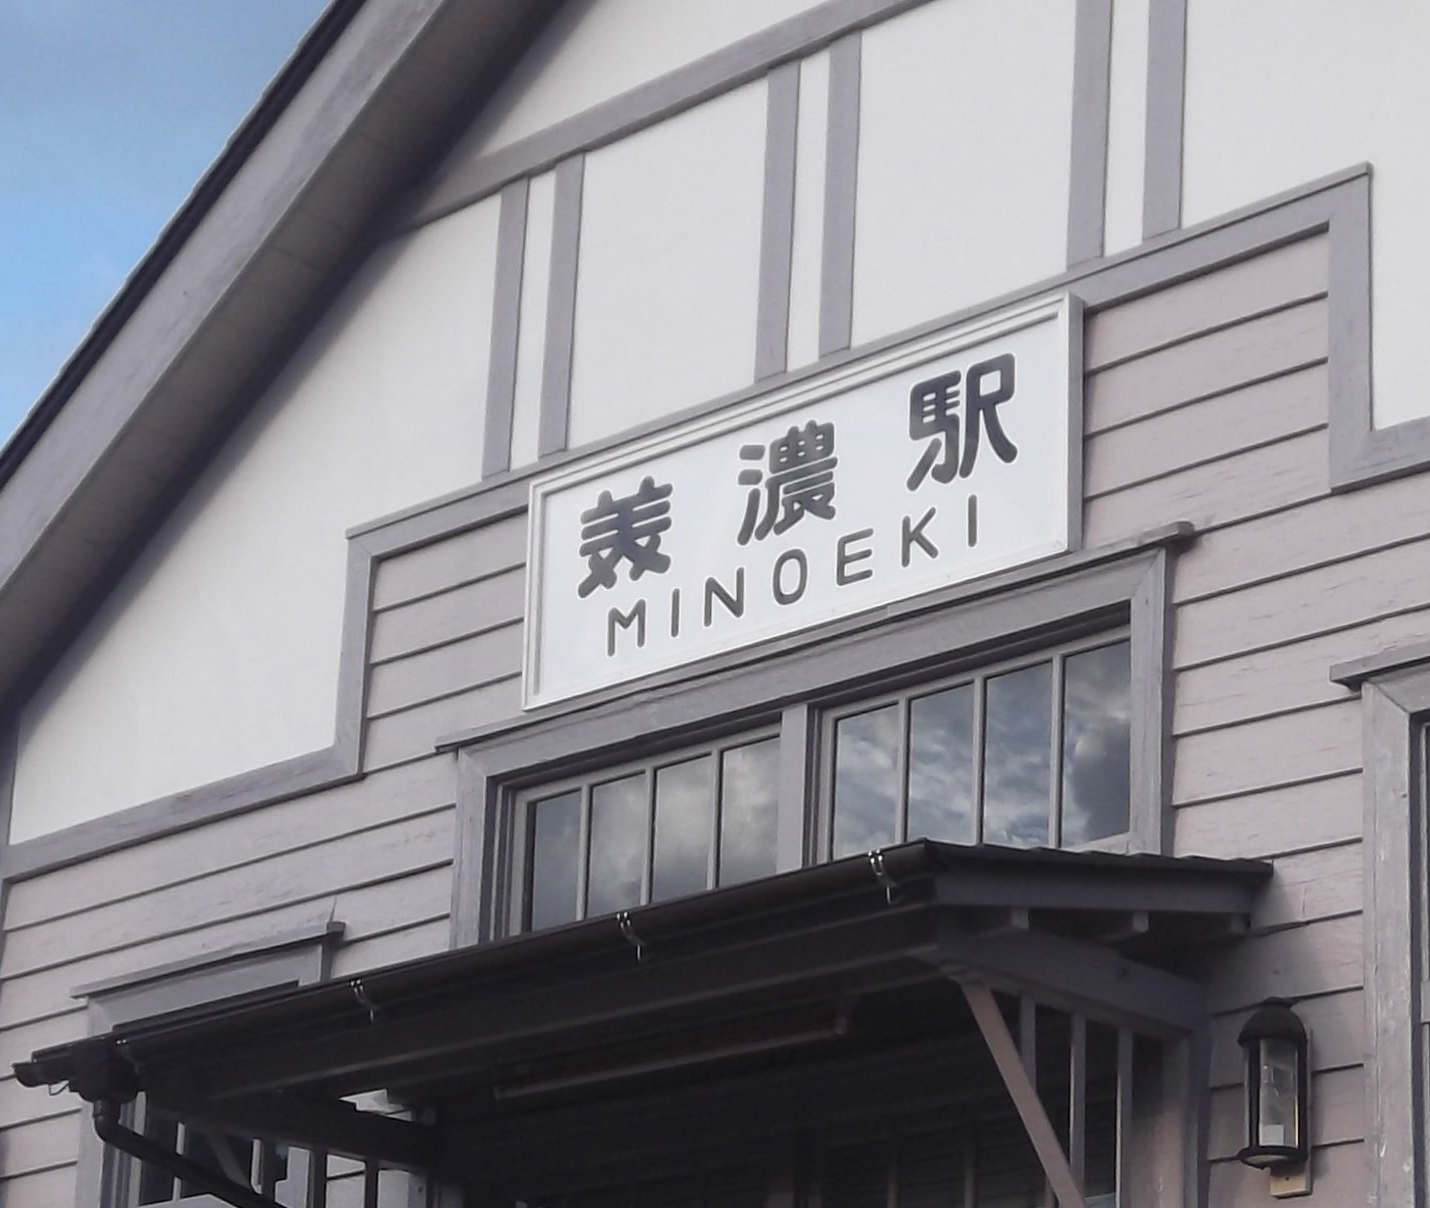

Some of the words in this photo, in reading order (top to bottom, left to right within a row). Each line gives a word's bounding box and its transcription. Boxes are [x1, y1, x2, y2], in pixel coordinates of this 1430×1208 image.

[576, 352, 1018, 599] 美濃駅
[606, 494, 978, 657] MINOEKI
